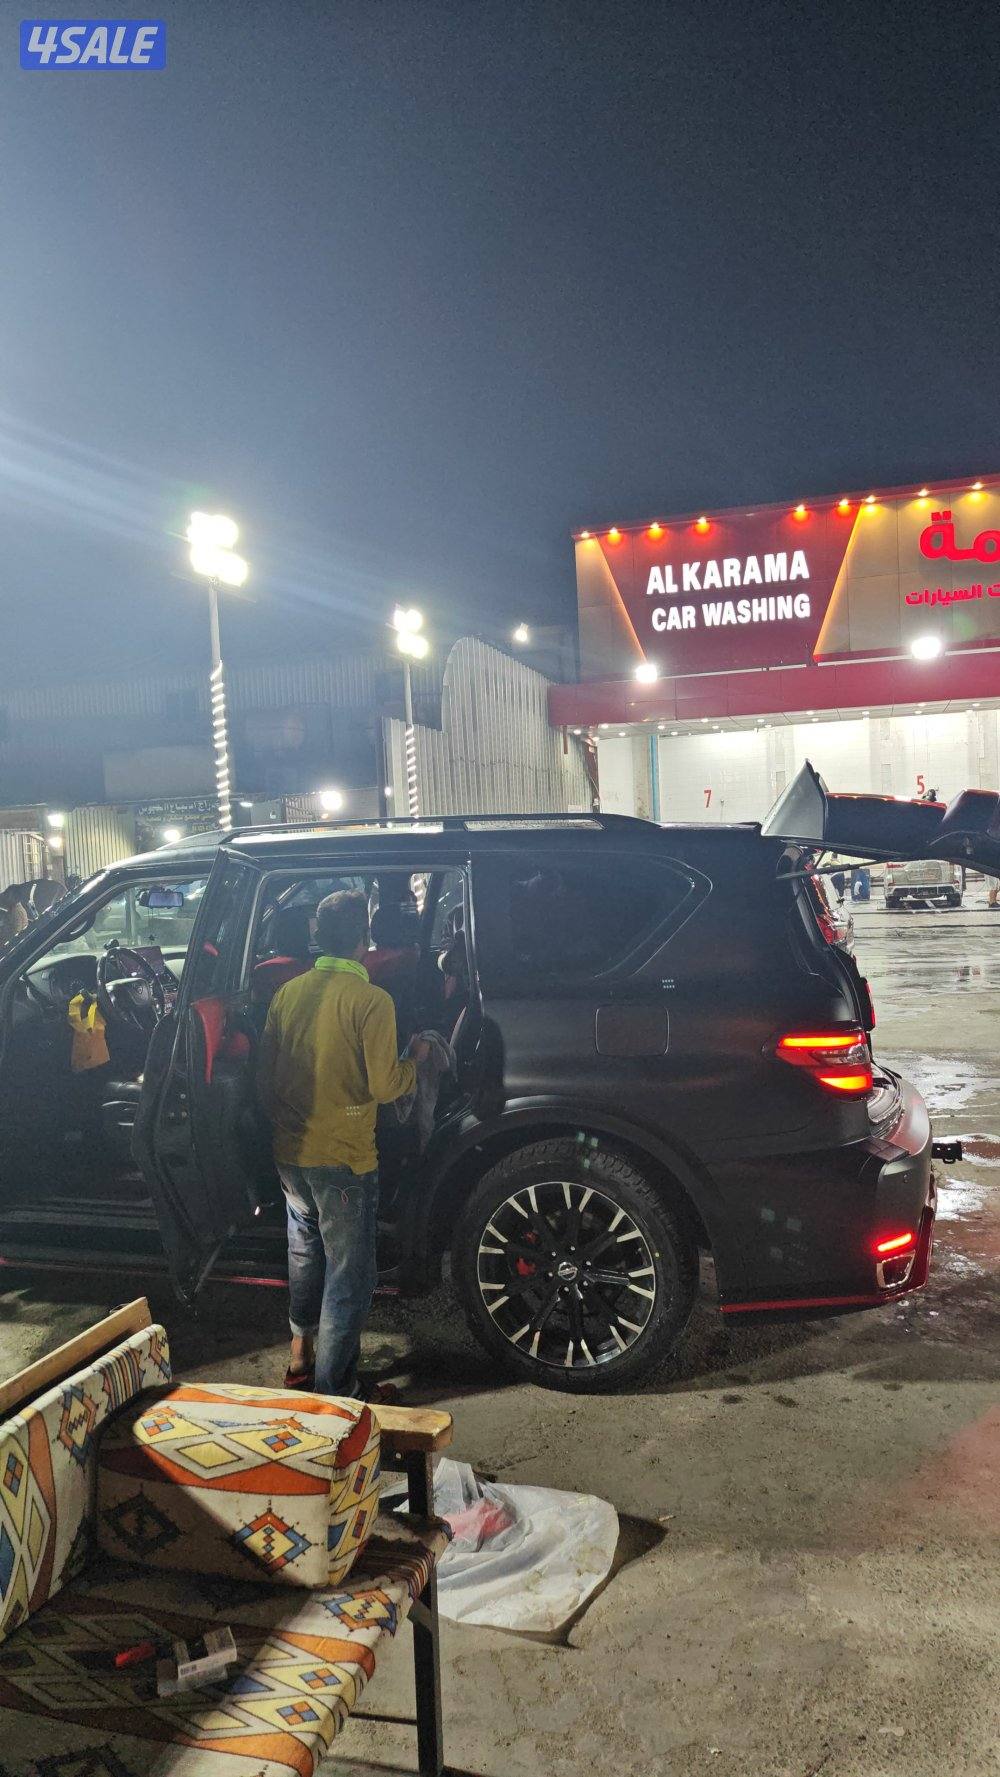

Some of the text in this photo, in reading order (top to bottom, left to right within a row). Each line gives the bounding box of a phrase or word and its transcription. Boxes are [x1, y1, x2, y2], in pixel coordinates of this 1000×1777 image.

[905, 584, 982, 607] السيارات
[651, 593, 811, 632] CAR WASHING
[916, 774, 925, 795] 5
[703, 789, 712, 808] 7
